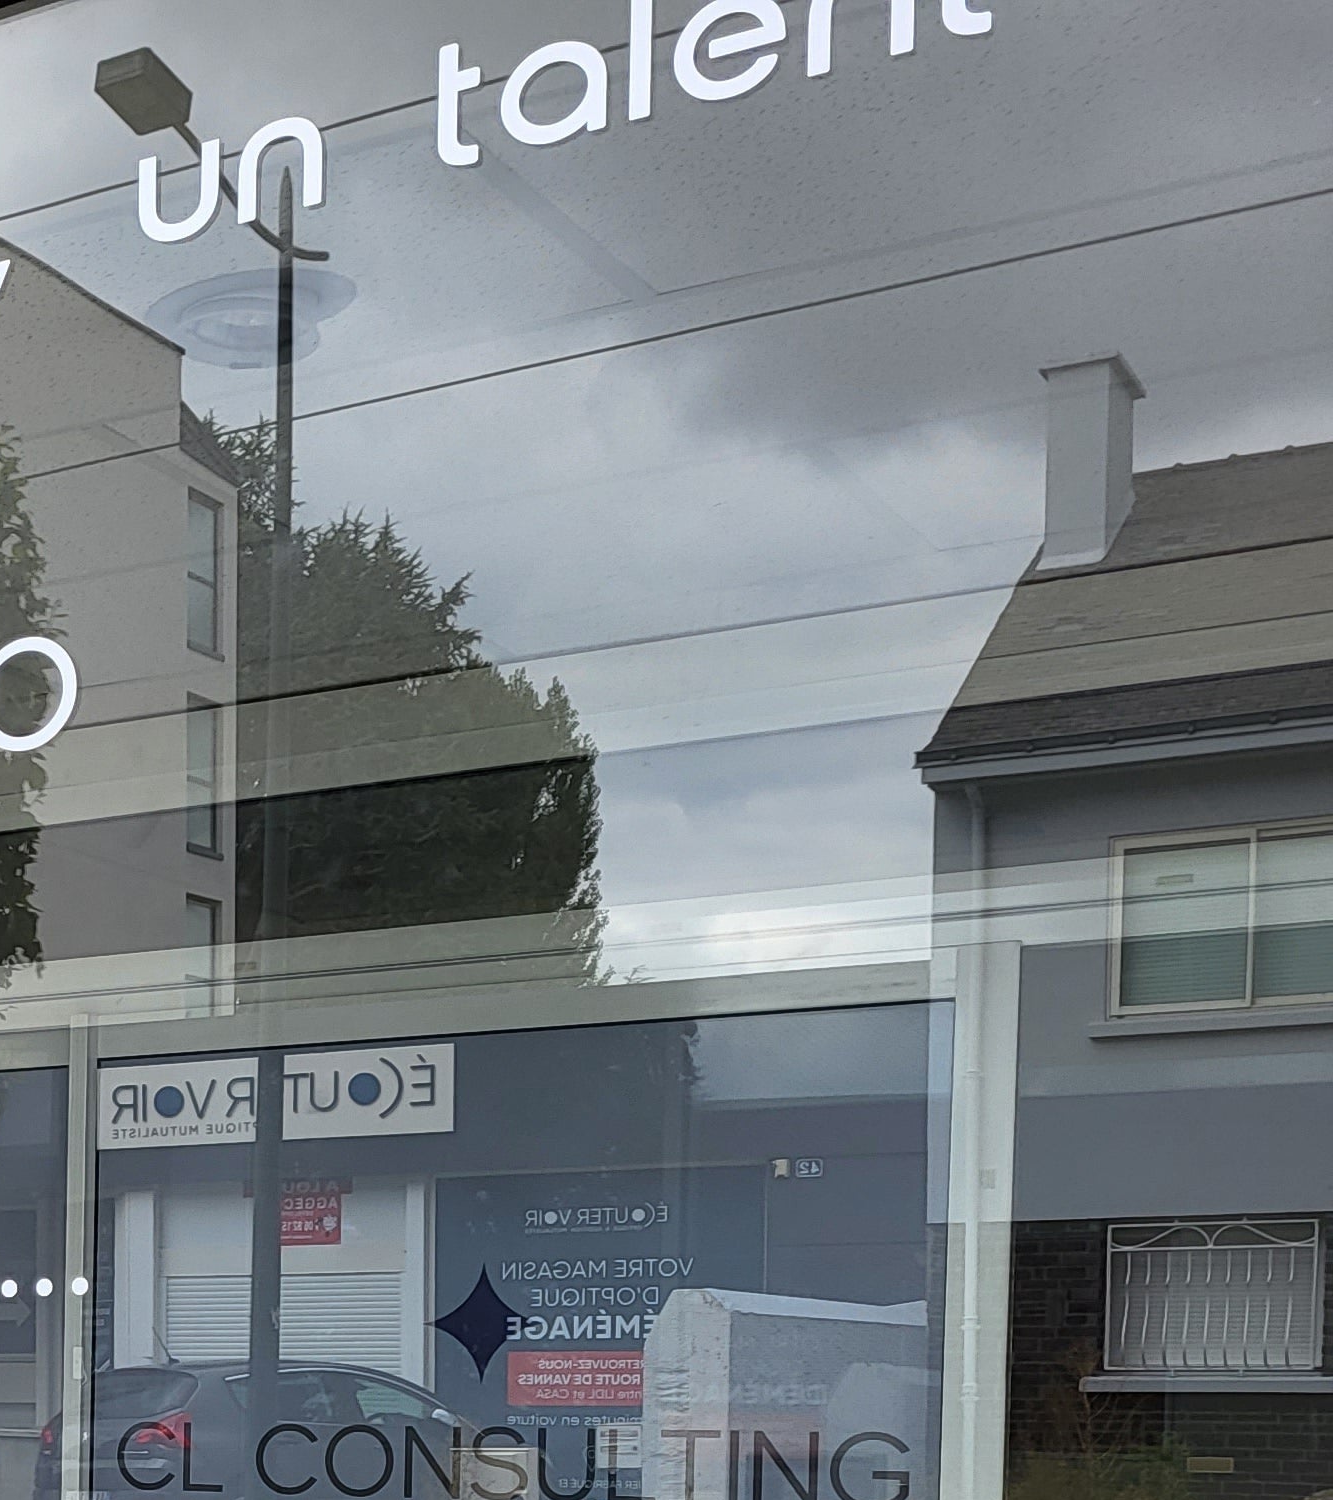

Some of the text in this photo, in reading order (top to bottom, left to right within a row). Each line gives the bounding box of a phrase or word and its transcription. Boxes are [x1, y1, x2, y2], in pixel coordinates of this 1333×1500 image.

[137, 0, 992, 244] un talen
[117, 1421, 224, 1492] CL
